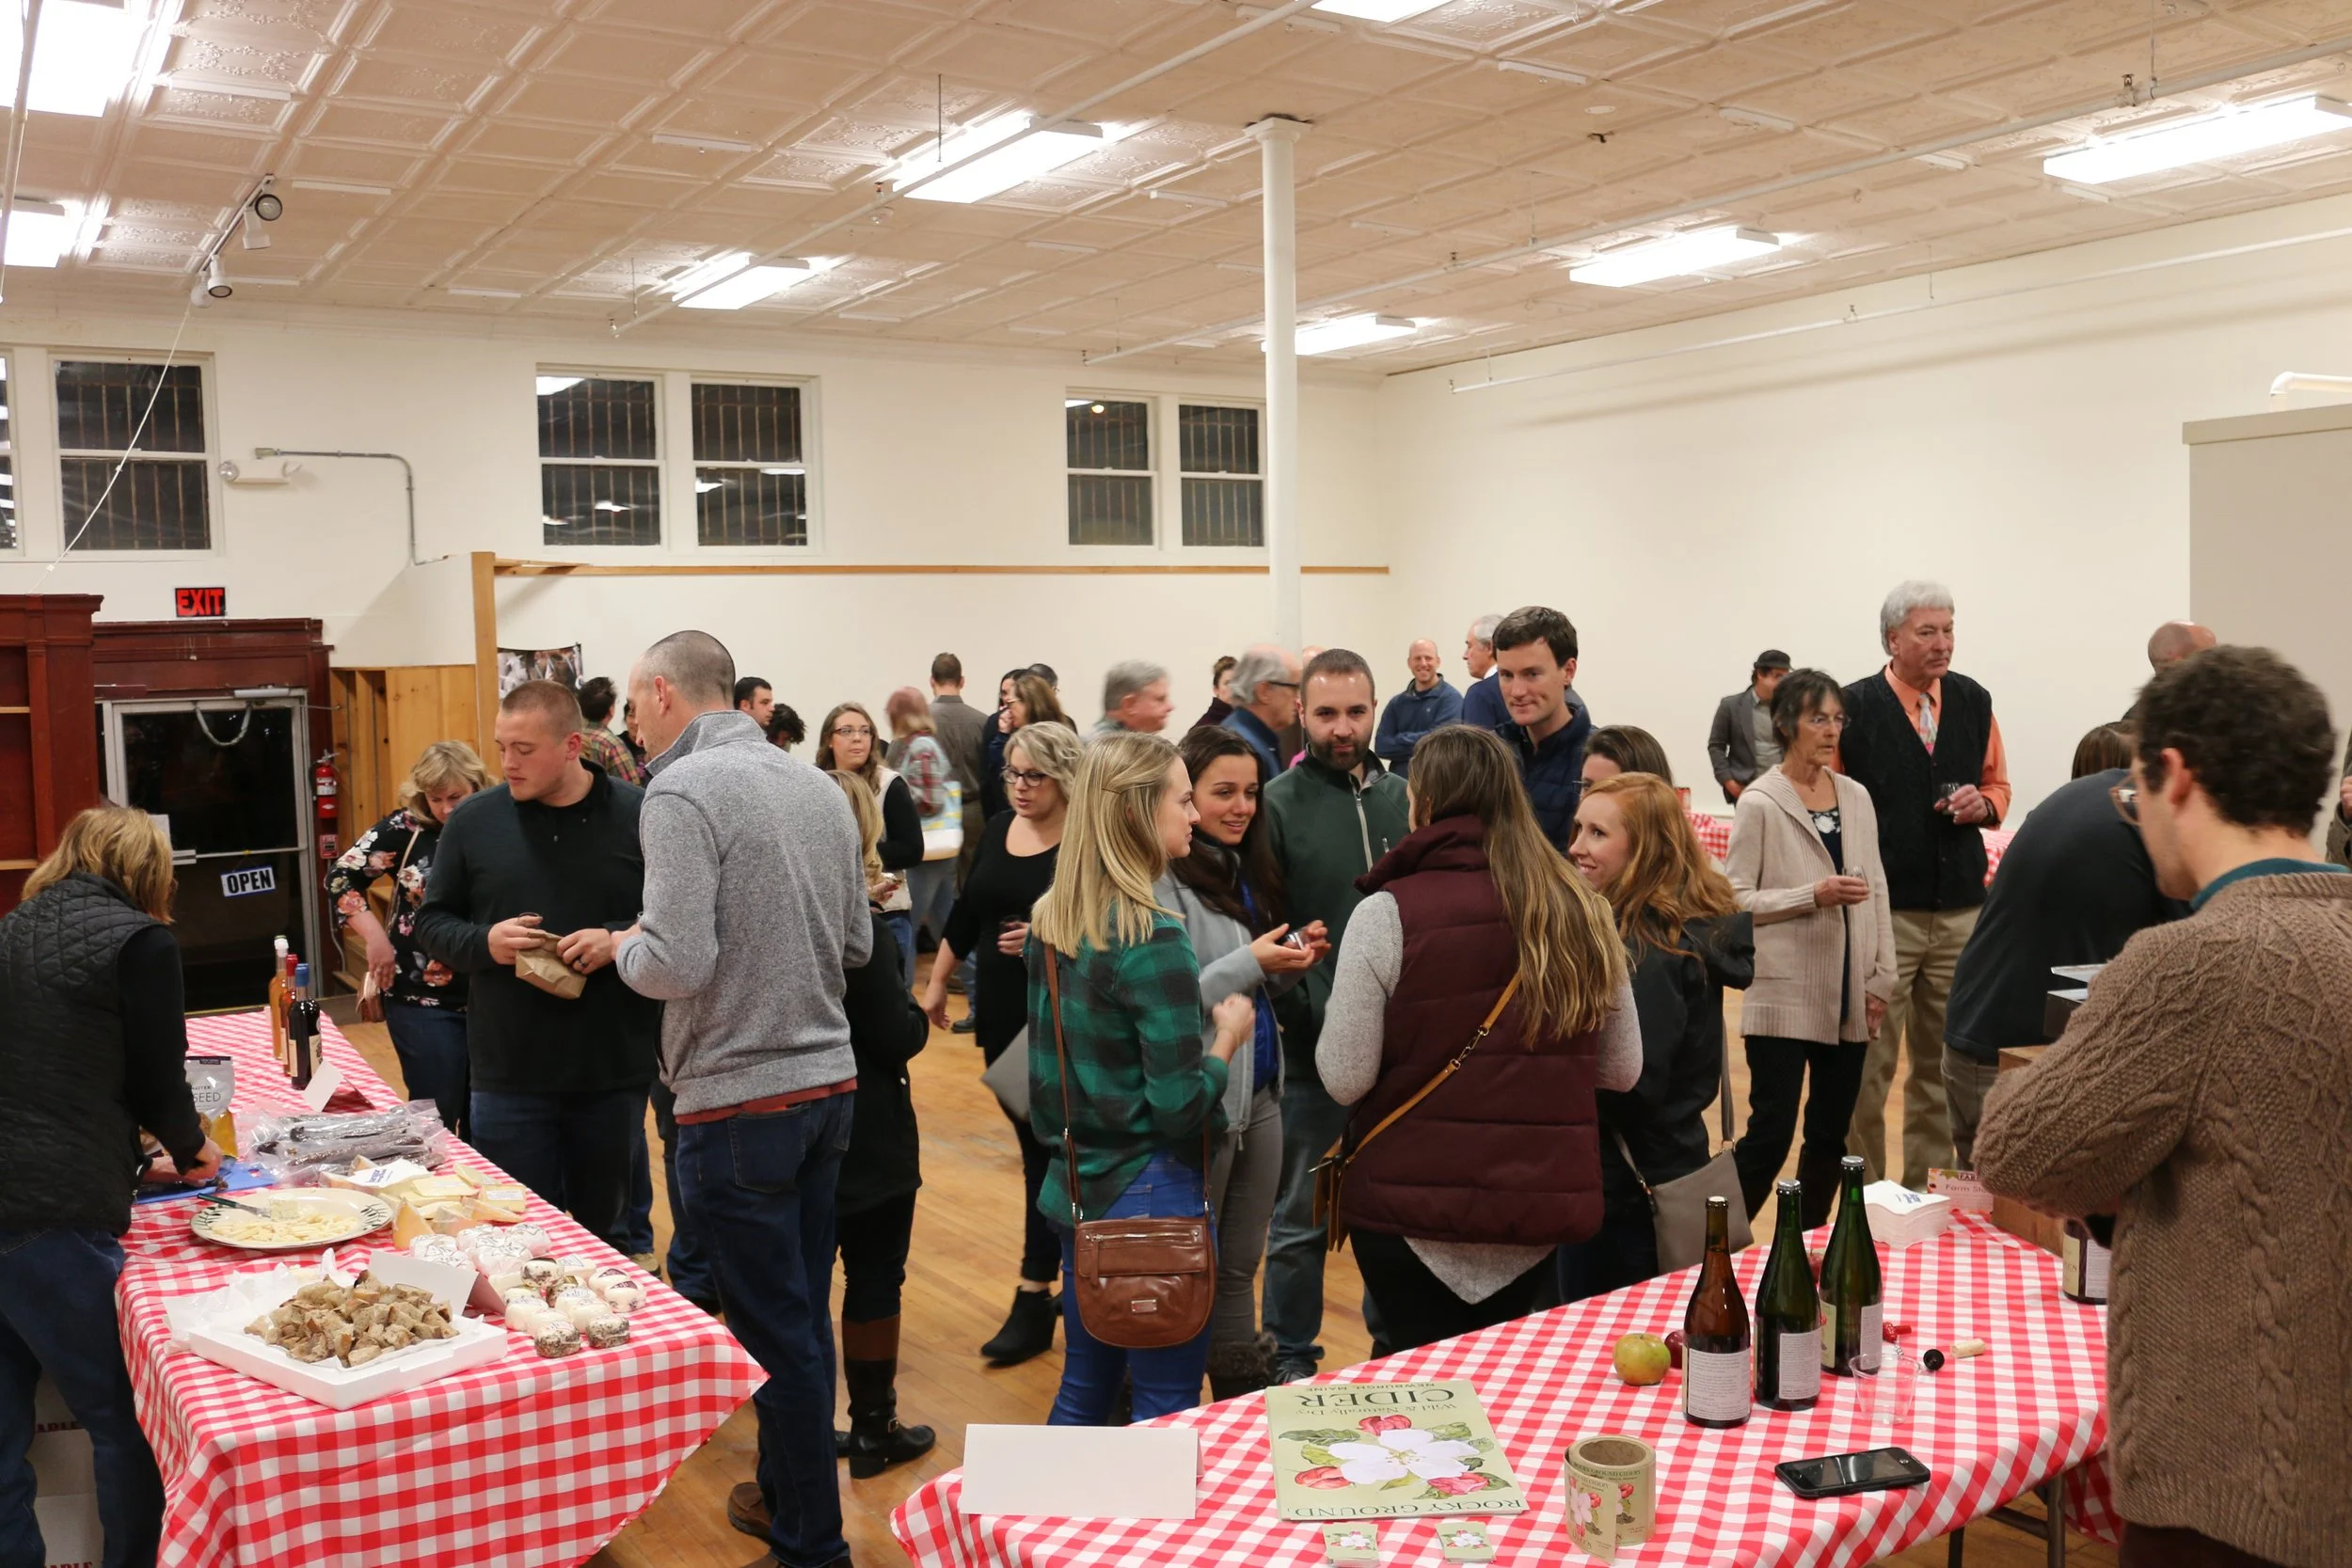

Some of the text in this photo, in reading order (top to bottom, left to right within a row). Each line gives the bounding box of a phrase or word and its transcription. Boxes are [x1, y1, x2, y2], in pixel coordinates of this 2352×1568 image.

[177, 589, 223, 616] EXIT
[227, 869, 272, 894] OPEN
[1946, 1183, 1970, 1192] Farm
[1294, 1389, 1454, 1408] CIDER
[1295, 1407, 1325, 1416] Dry
[1329, 1406, 1398, 1416] Naturally
[1422, 1402, 1456, 1411] Wild
[1295, 1498, 1521, 1517] ROCKY GROUND
